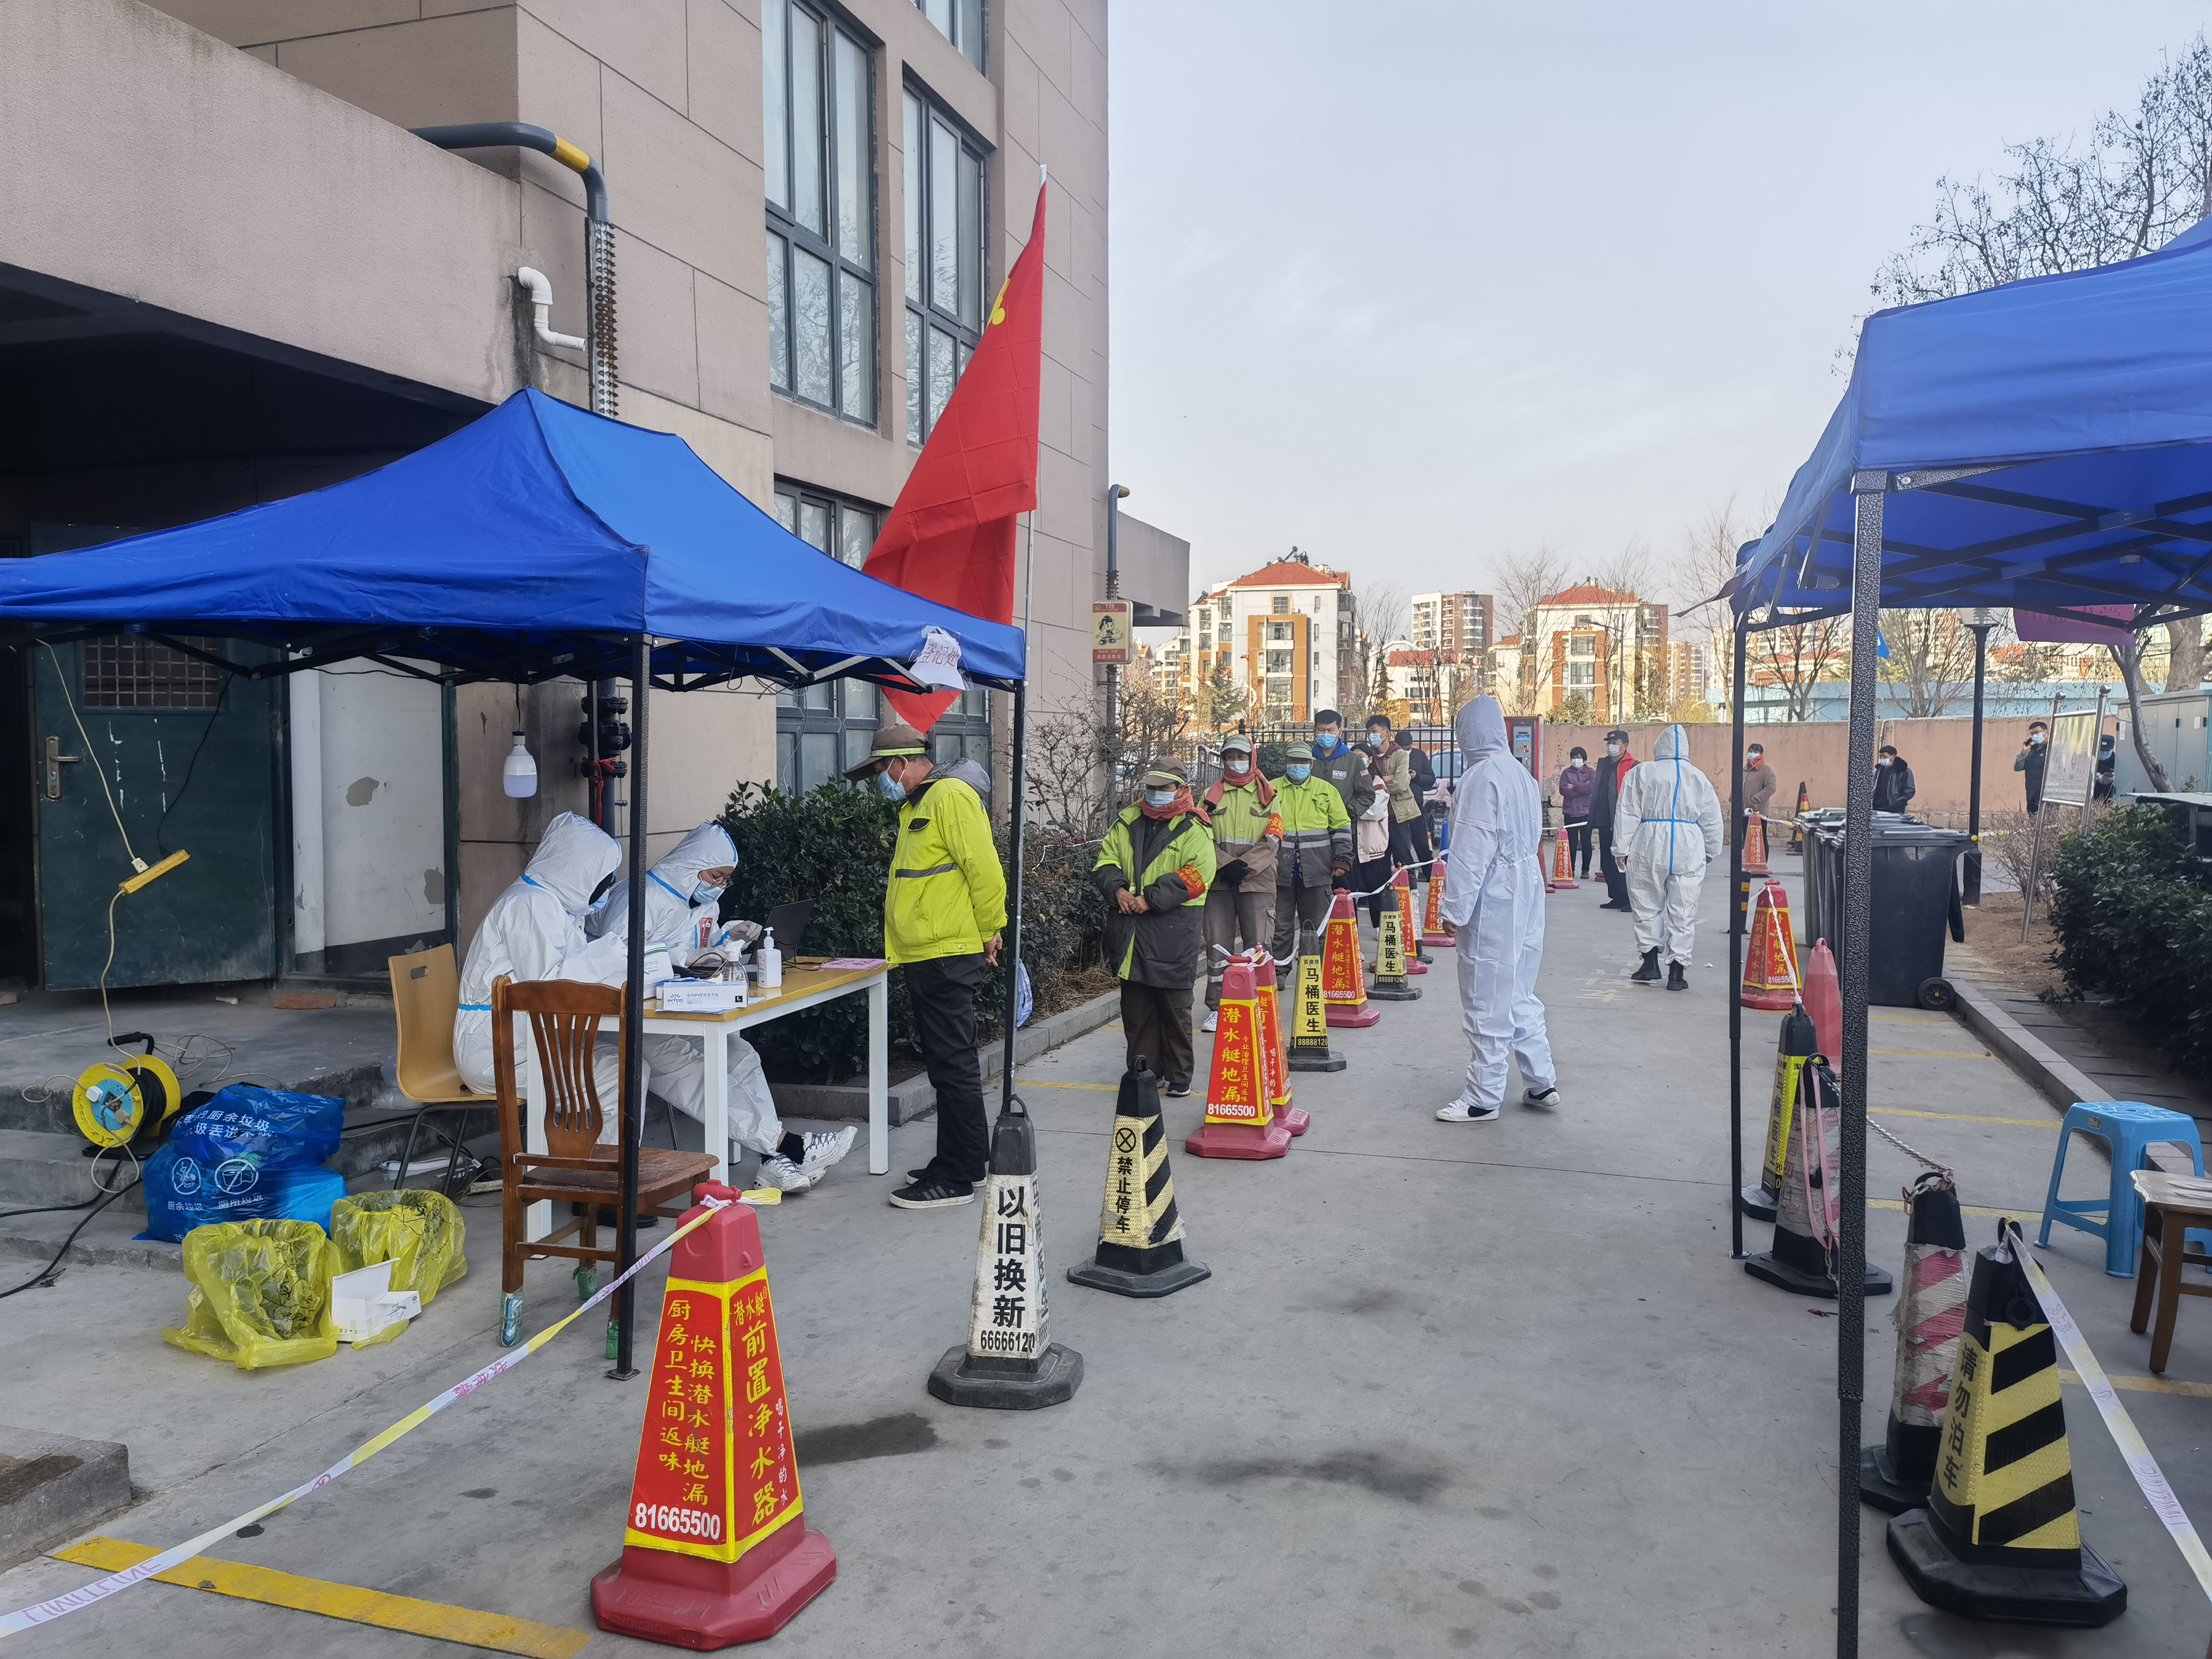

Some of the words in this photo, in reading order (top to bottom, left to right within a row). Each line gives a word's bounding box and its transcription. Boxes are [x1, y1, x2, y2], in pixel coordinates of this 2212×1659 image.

[919, 643, 960, 667] 登记处
[1331, 925, 1345, 989] 潜水艇地漏
[1385, 921, 1397, 972] 马桶医生
[1305, 968, 1320, 1033] 马桶医生
[1324, 990, 1355, 999] 81665500
[1768, 975, 1792, 983] 8166550
[1221, 1007, 1242, 1102] 潜水艇地漏
[1241, 1036, 1249, 1102] 专业治理卫生间返味
[1298, 1038, 1328, 1046] 88888120
[1208, 1103, 1256, 1117] 81665500
[167, 1200, 205, 1212] 厨余垃圾
[1116, 1156, 1133, 1233] 禁止停车
[993, 1186, 1029, 1328] 以旧换新
[980, 1330, 1035, 1353] 66666120
[659, 1299, 691, 1471] 厨房卫生间返味
[1943, 1343, 1978, 1489] 请勿泊车
[683, 1335, 717, 1506] 快换潜水艇地漏
[742, 1320, 779, 1528] 前置净水器
[775, 1398, 789, 1507] 喝干净的水
[635, 1502, 721, 1540] 81665500
